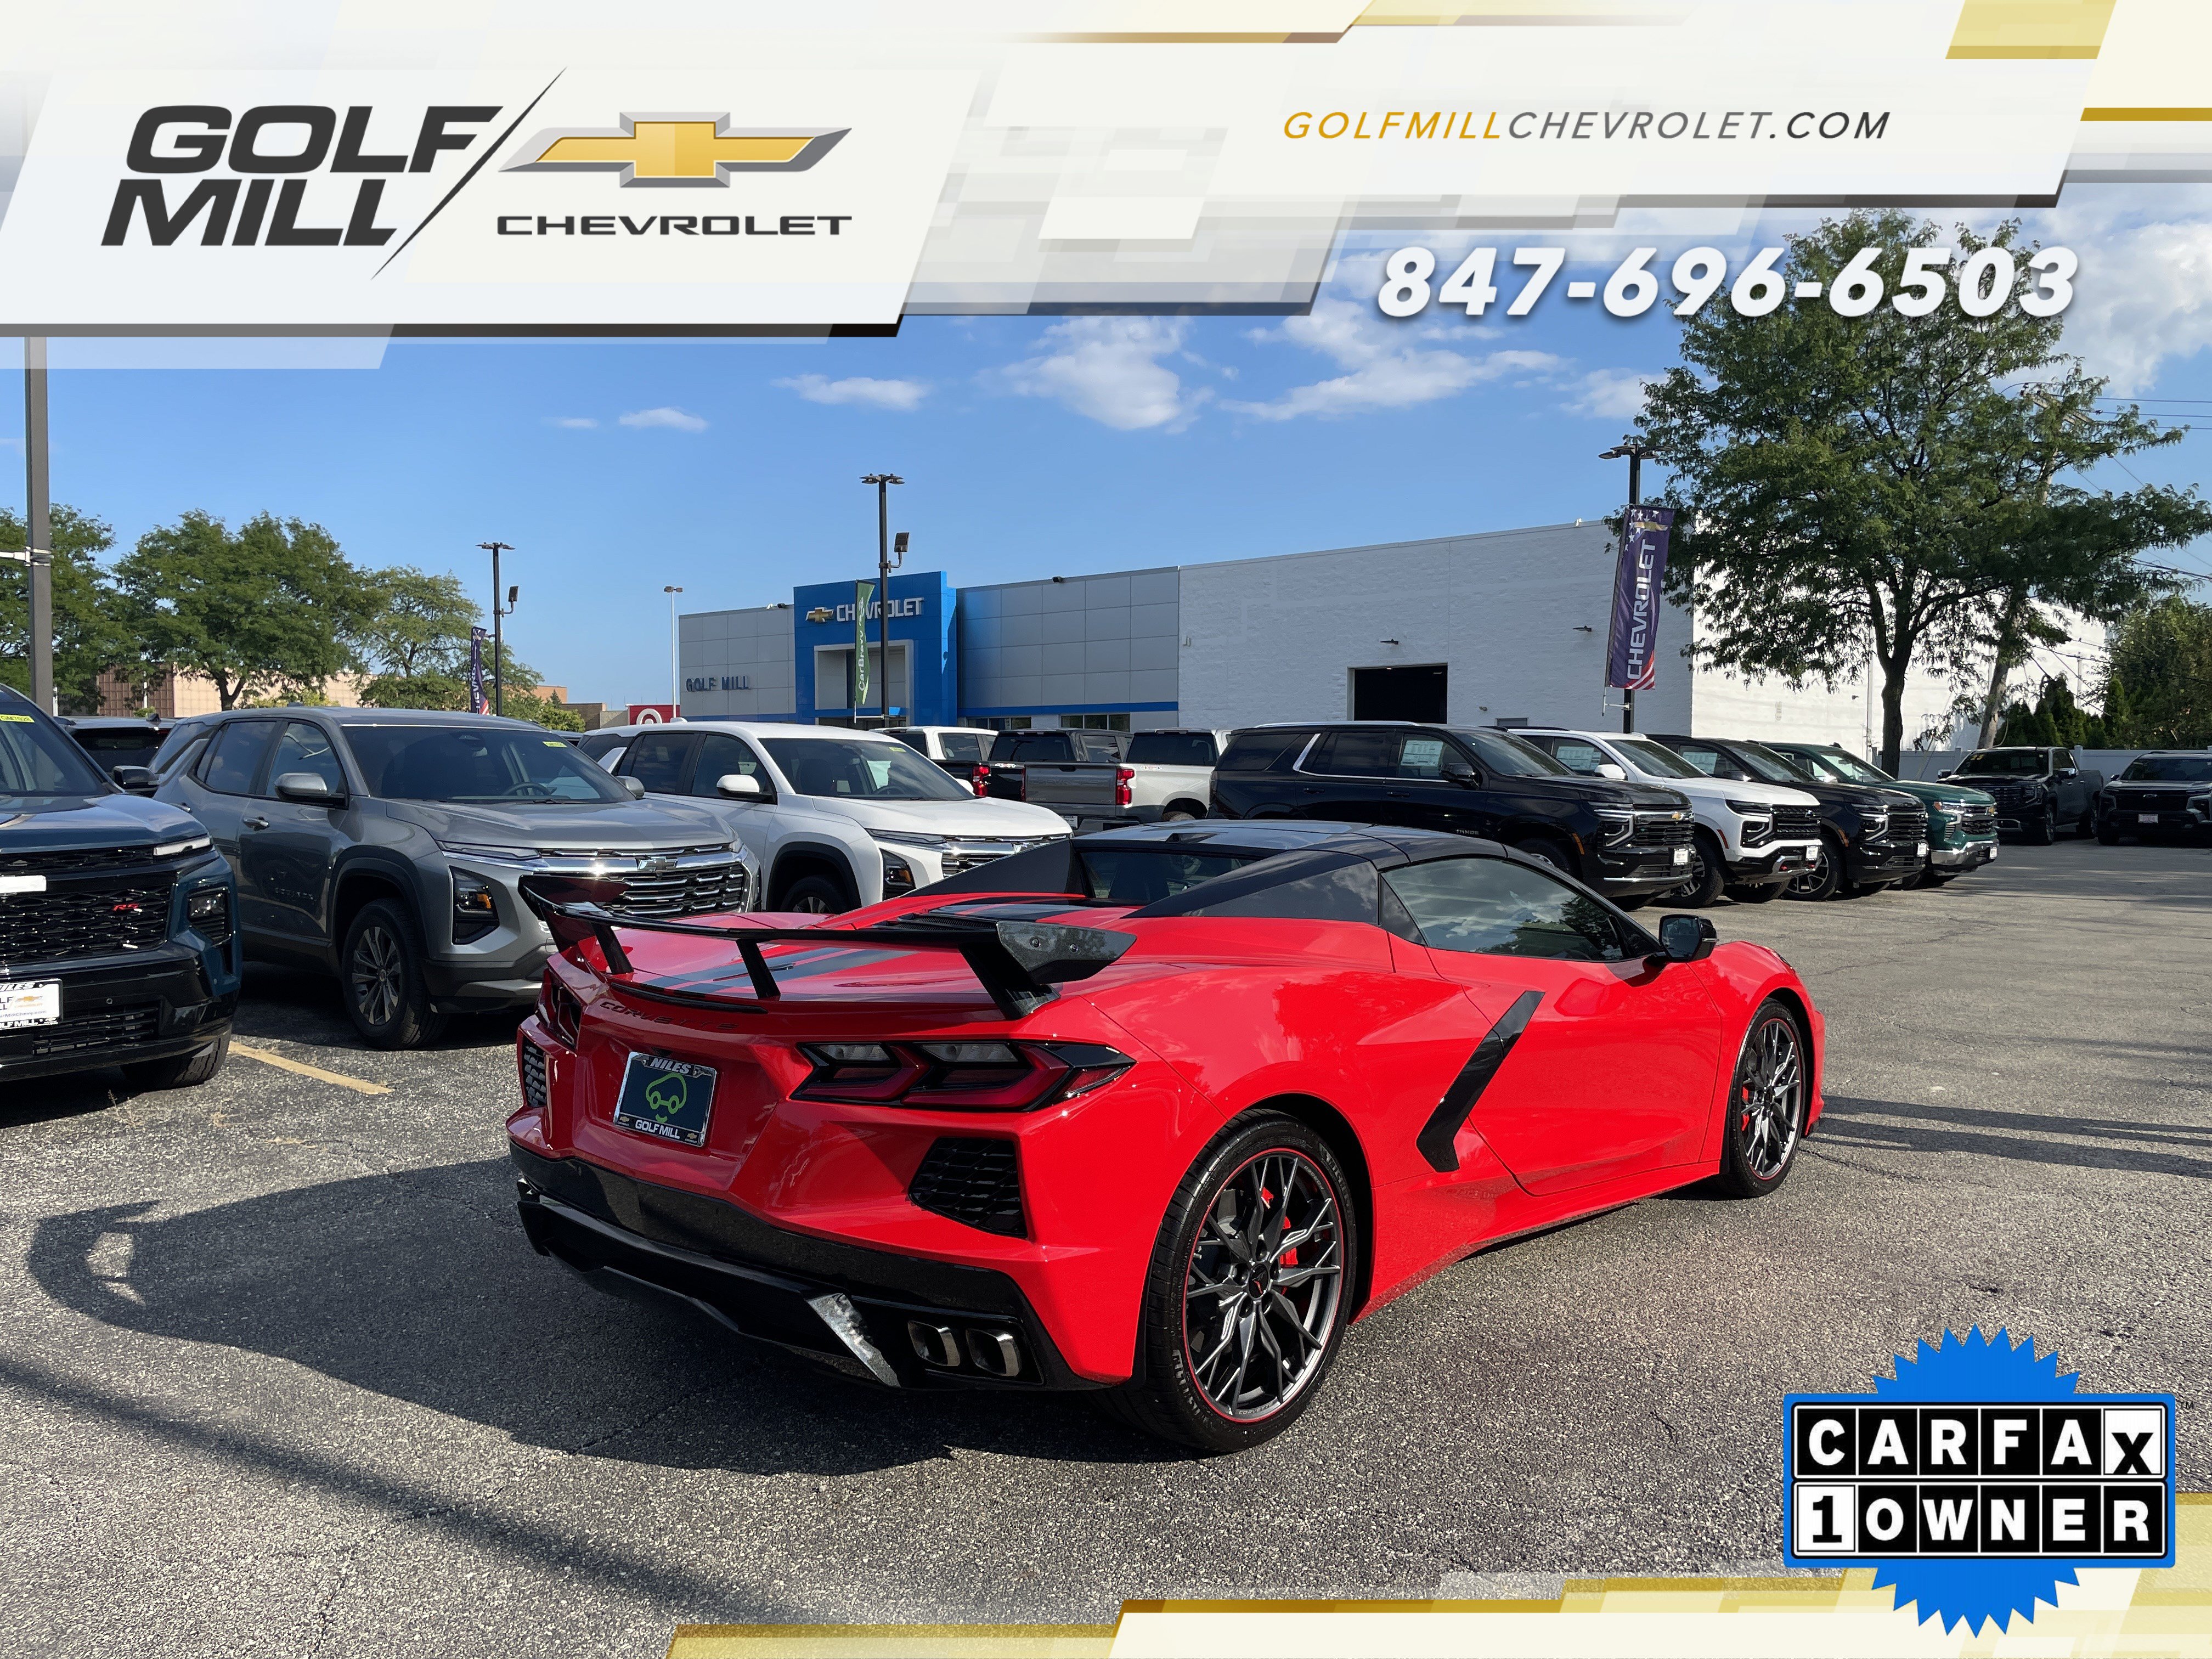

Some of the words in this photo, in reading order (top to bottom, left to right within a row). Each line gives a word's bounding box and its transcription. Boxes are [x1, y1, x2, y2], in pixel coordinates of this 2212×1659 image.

[837, 597, 924, 622] CHVROLET
[1627, 539, 1656, 680] CHEVROLET
[686, 677, 716, 692] GOLF
[721, 675, 749, 690] MILL
[600, 1001, 740, 1030] CORVETTE
[650, 1058, 692, 1074] NILES
[635, 1119, 660, 1133] GOLF
[659, 1126, 680, 1139] MILL
